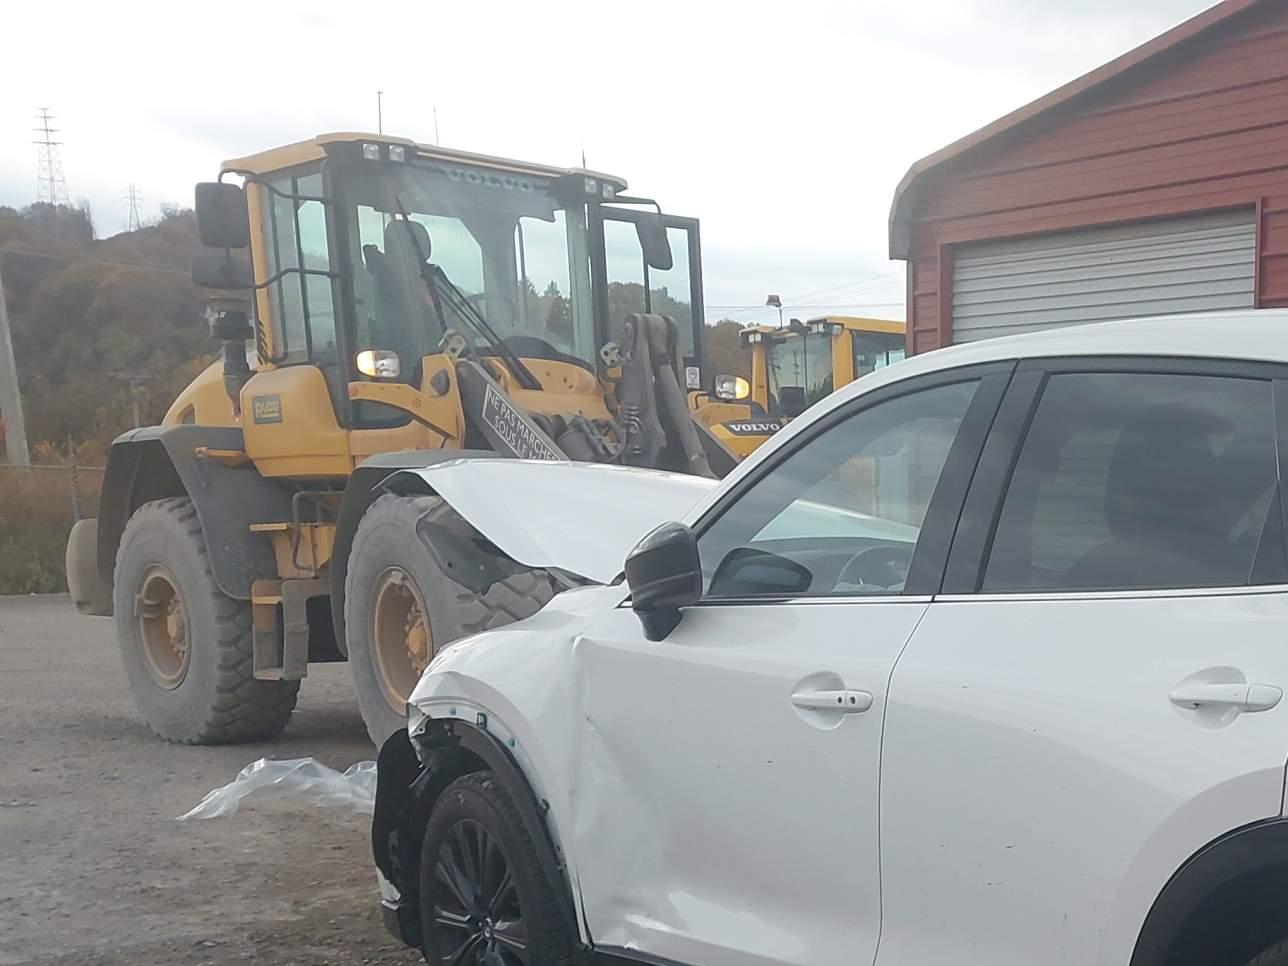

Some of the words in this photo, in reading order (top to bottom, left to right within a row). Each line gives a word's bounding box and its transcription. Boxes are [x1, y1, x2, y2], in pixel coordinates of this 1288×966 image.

[487, 390, 500, 411] NE
[500, 402, 516, 427] PAS
[494, 415, 517, 446] SOUS
[517, 438, 528, 457] LE
[729, 423, 780, 432] VOLVO
